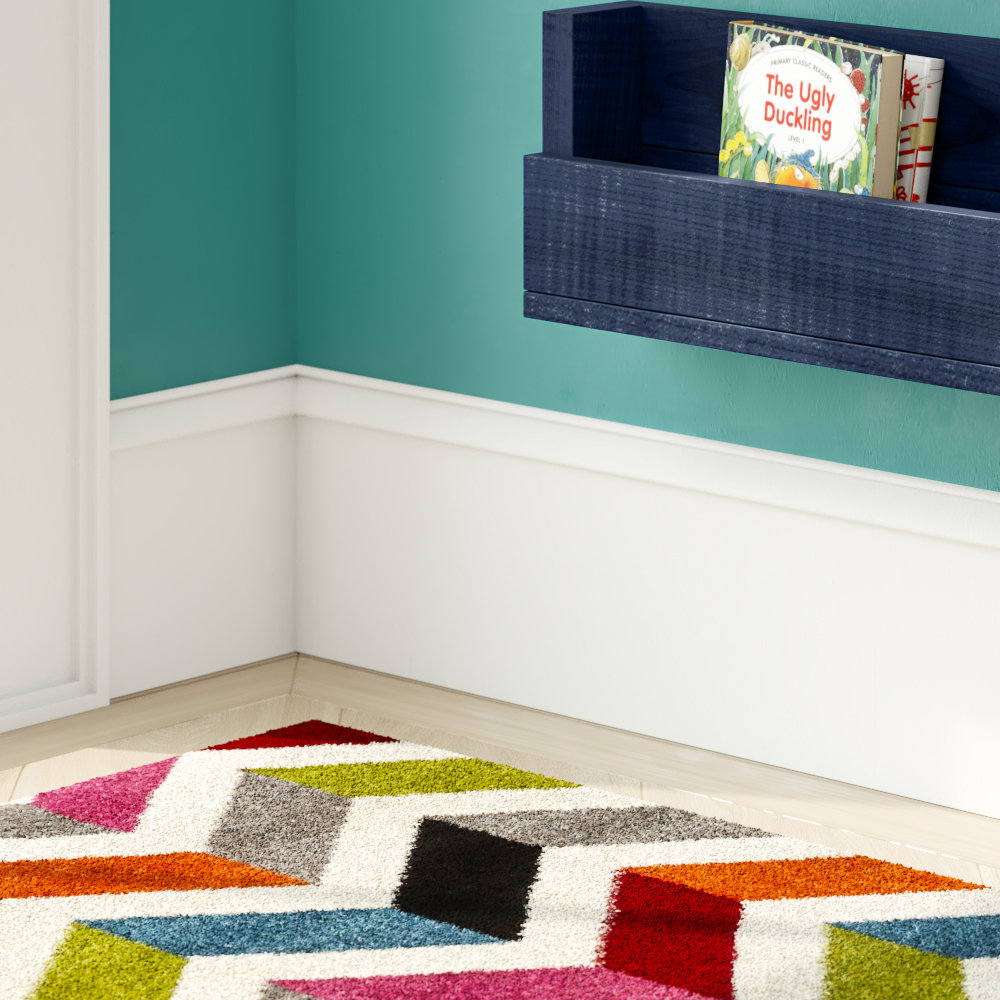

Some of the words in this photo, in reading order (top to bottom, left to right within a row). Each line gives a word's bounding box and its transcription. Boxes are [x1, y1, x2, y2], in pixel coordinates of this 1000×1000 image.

[771, 58, 792, 67] PRIMARY
[793, 58, 811, 69] CLASSIC
[812, 64, 832, 83] READERS
[766, 73, 793, 99] The
[799, 80, 836, 114] Ugly
[764, 100, 832, 141] Duckling
[788, 135, 801, 143] LEVEL
